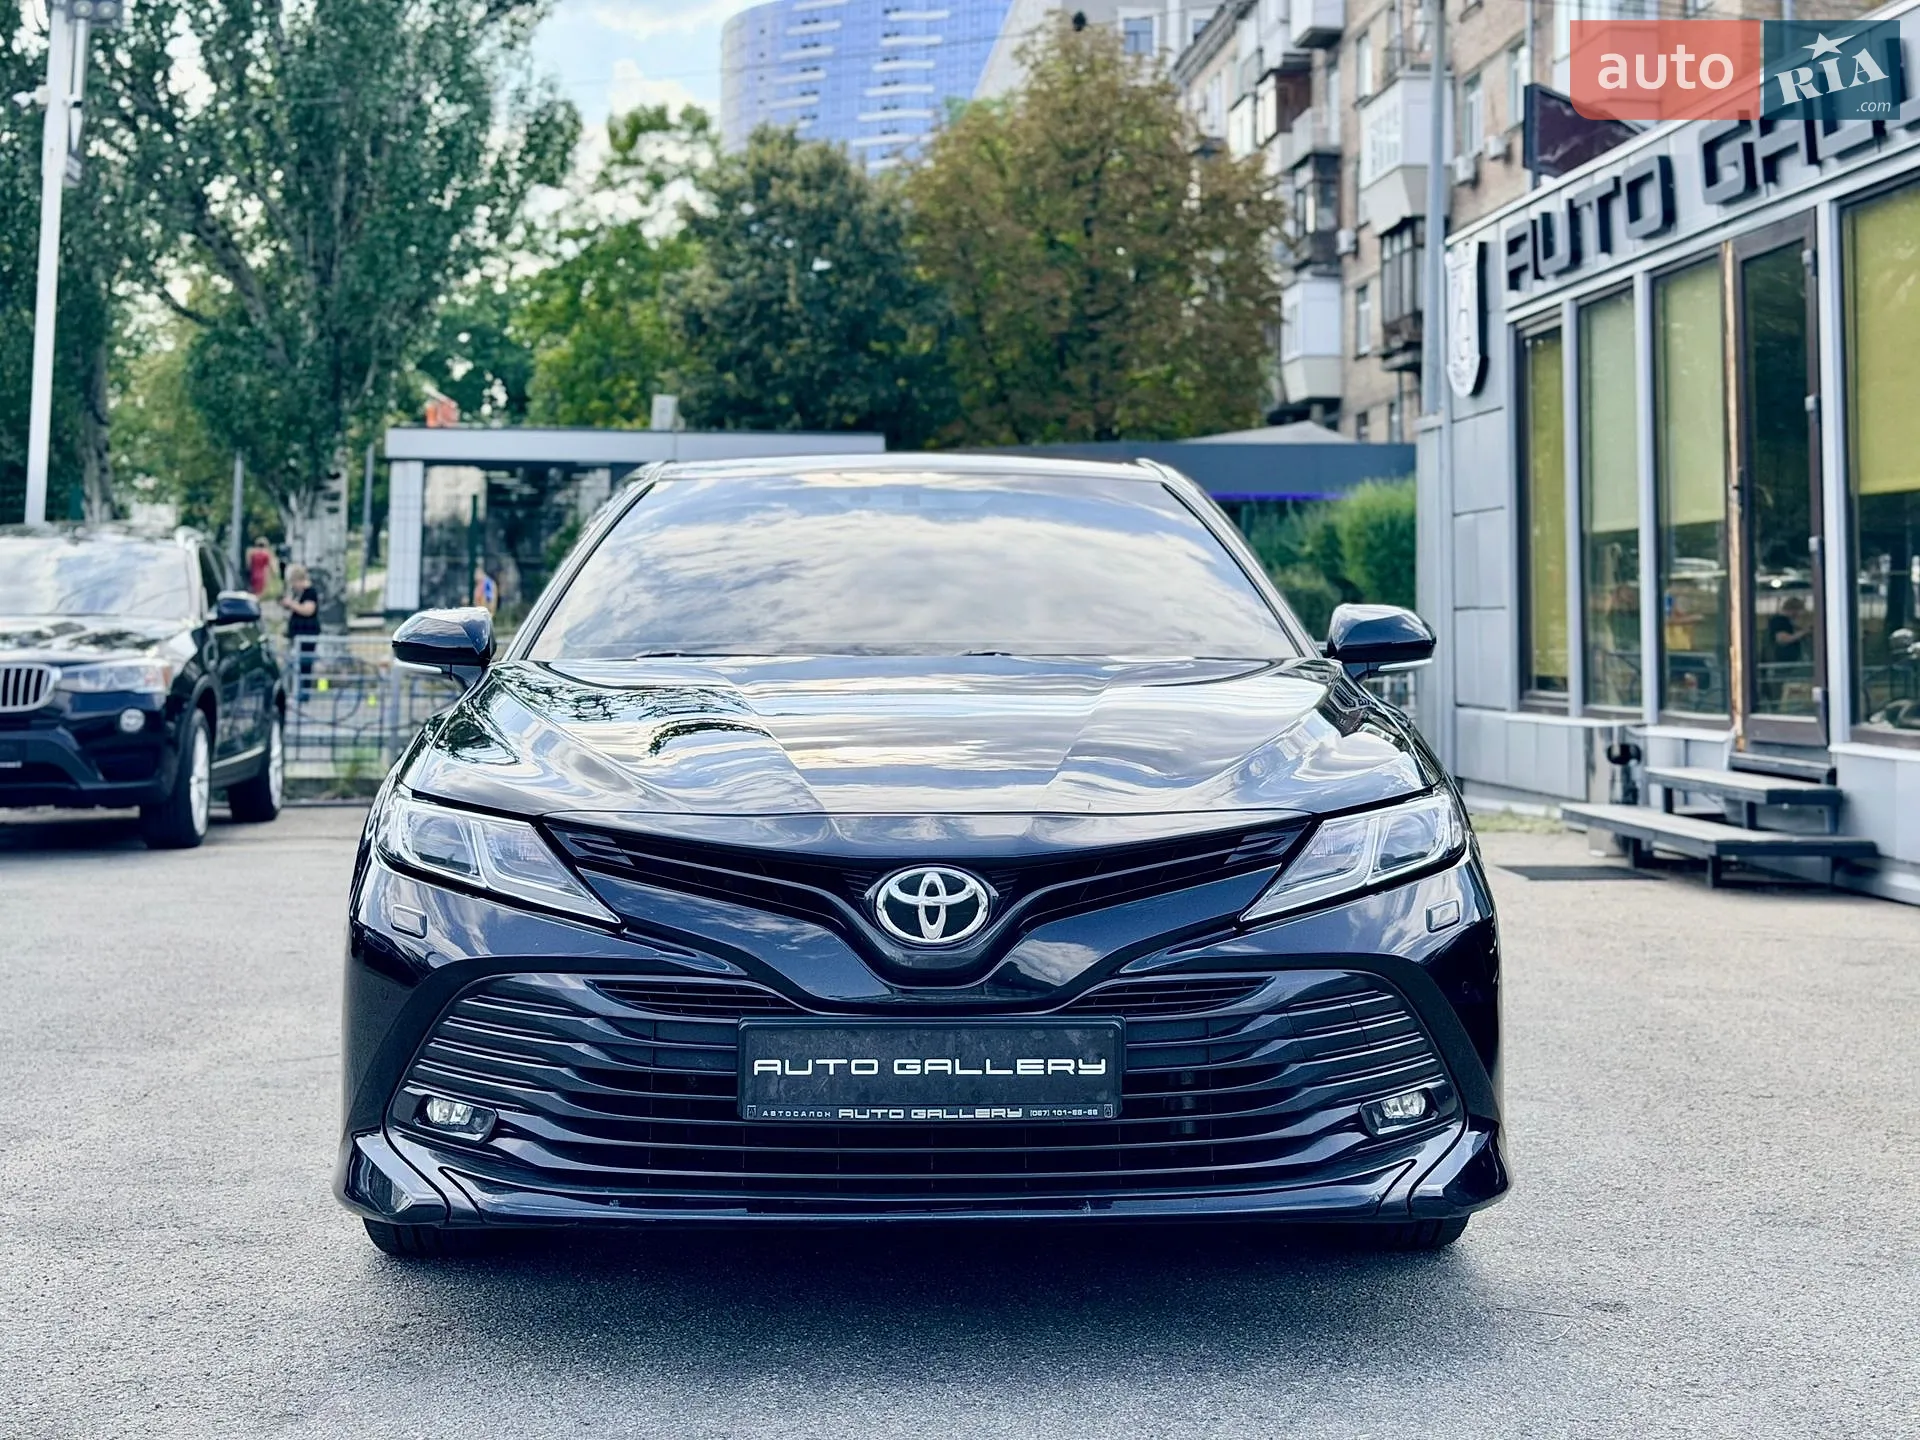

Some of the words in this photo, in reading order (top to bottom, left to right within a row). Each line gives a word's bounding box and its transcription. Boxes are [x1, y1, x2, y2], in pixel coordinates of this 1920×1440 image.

[1506, 155, 1675, 291] AUTO
[753, 1058, 880, 1076] AUTO
[893, 1058, 1106, 1076] GALLERY
[838, 1108, 904, 1119] AUTO
[911, 1107, 1022, 1119] GALLERY
